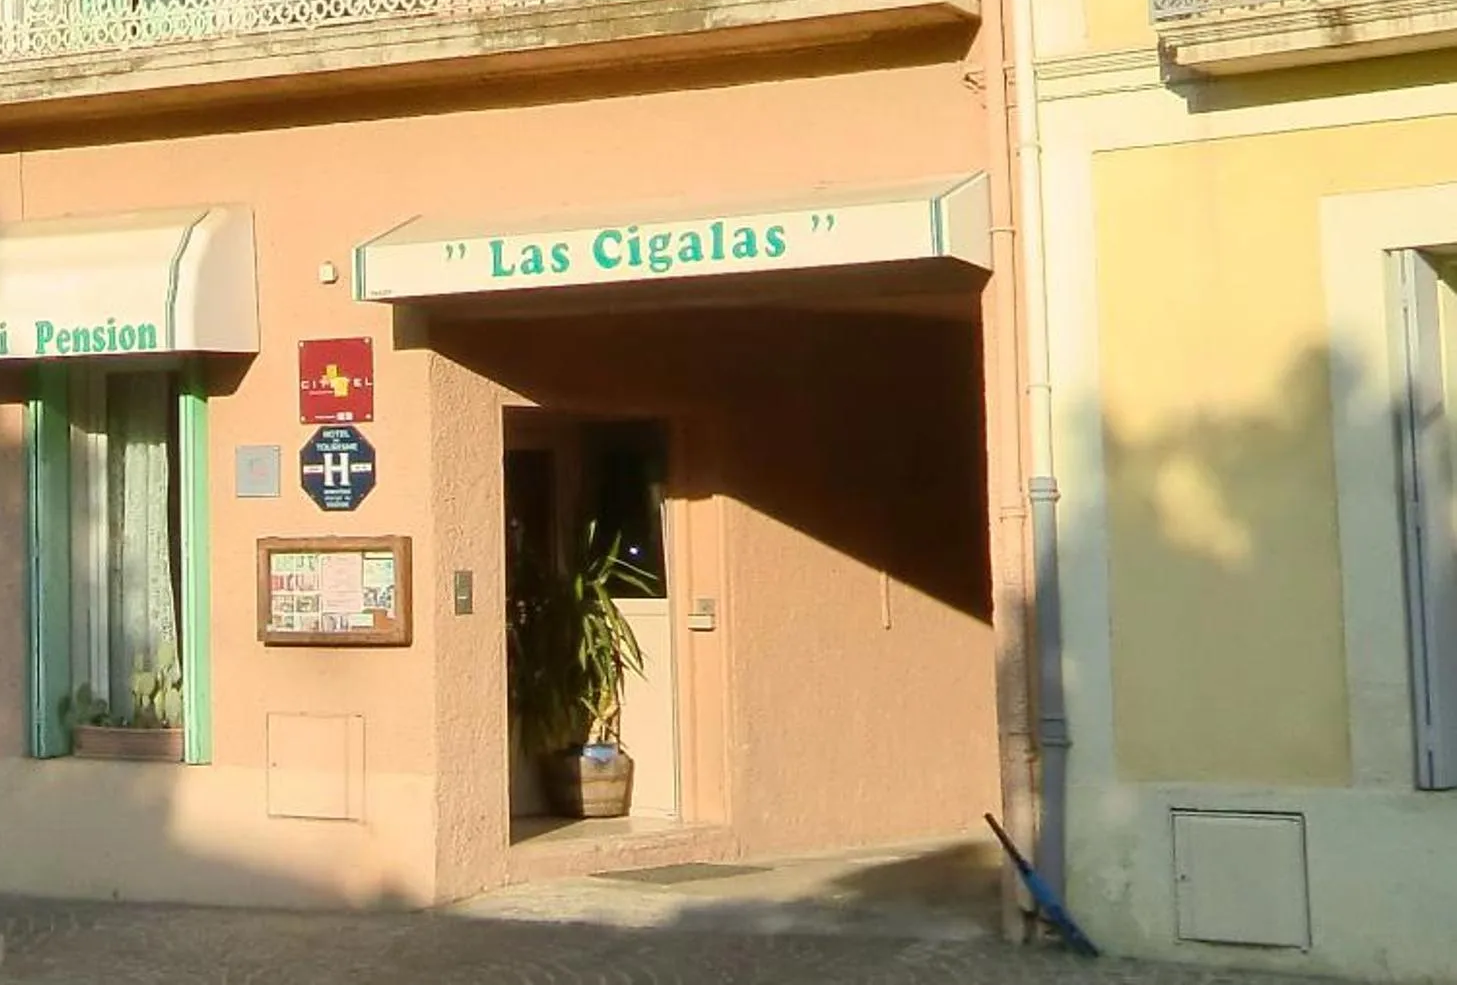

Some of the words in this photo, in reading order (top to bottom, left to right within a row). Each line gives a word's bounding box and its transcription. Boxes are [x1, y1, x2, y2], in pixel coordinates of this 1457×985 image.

[489, 239, 570, 277] Las
[593, 220, 787, 274] Cigalas
[34, 317, 158, 355] Pension
[323, 452, 351, 487] H
